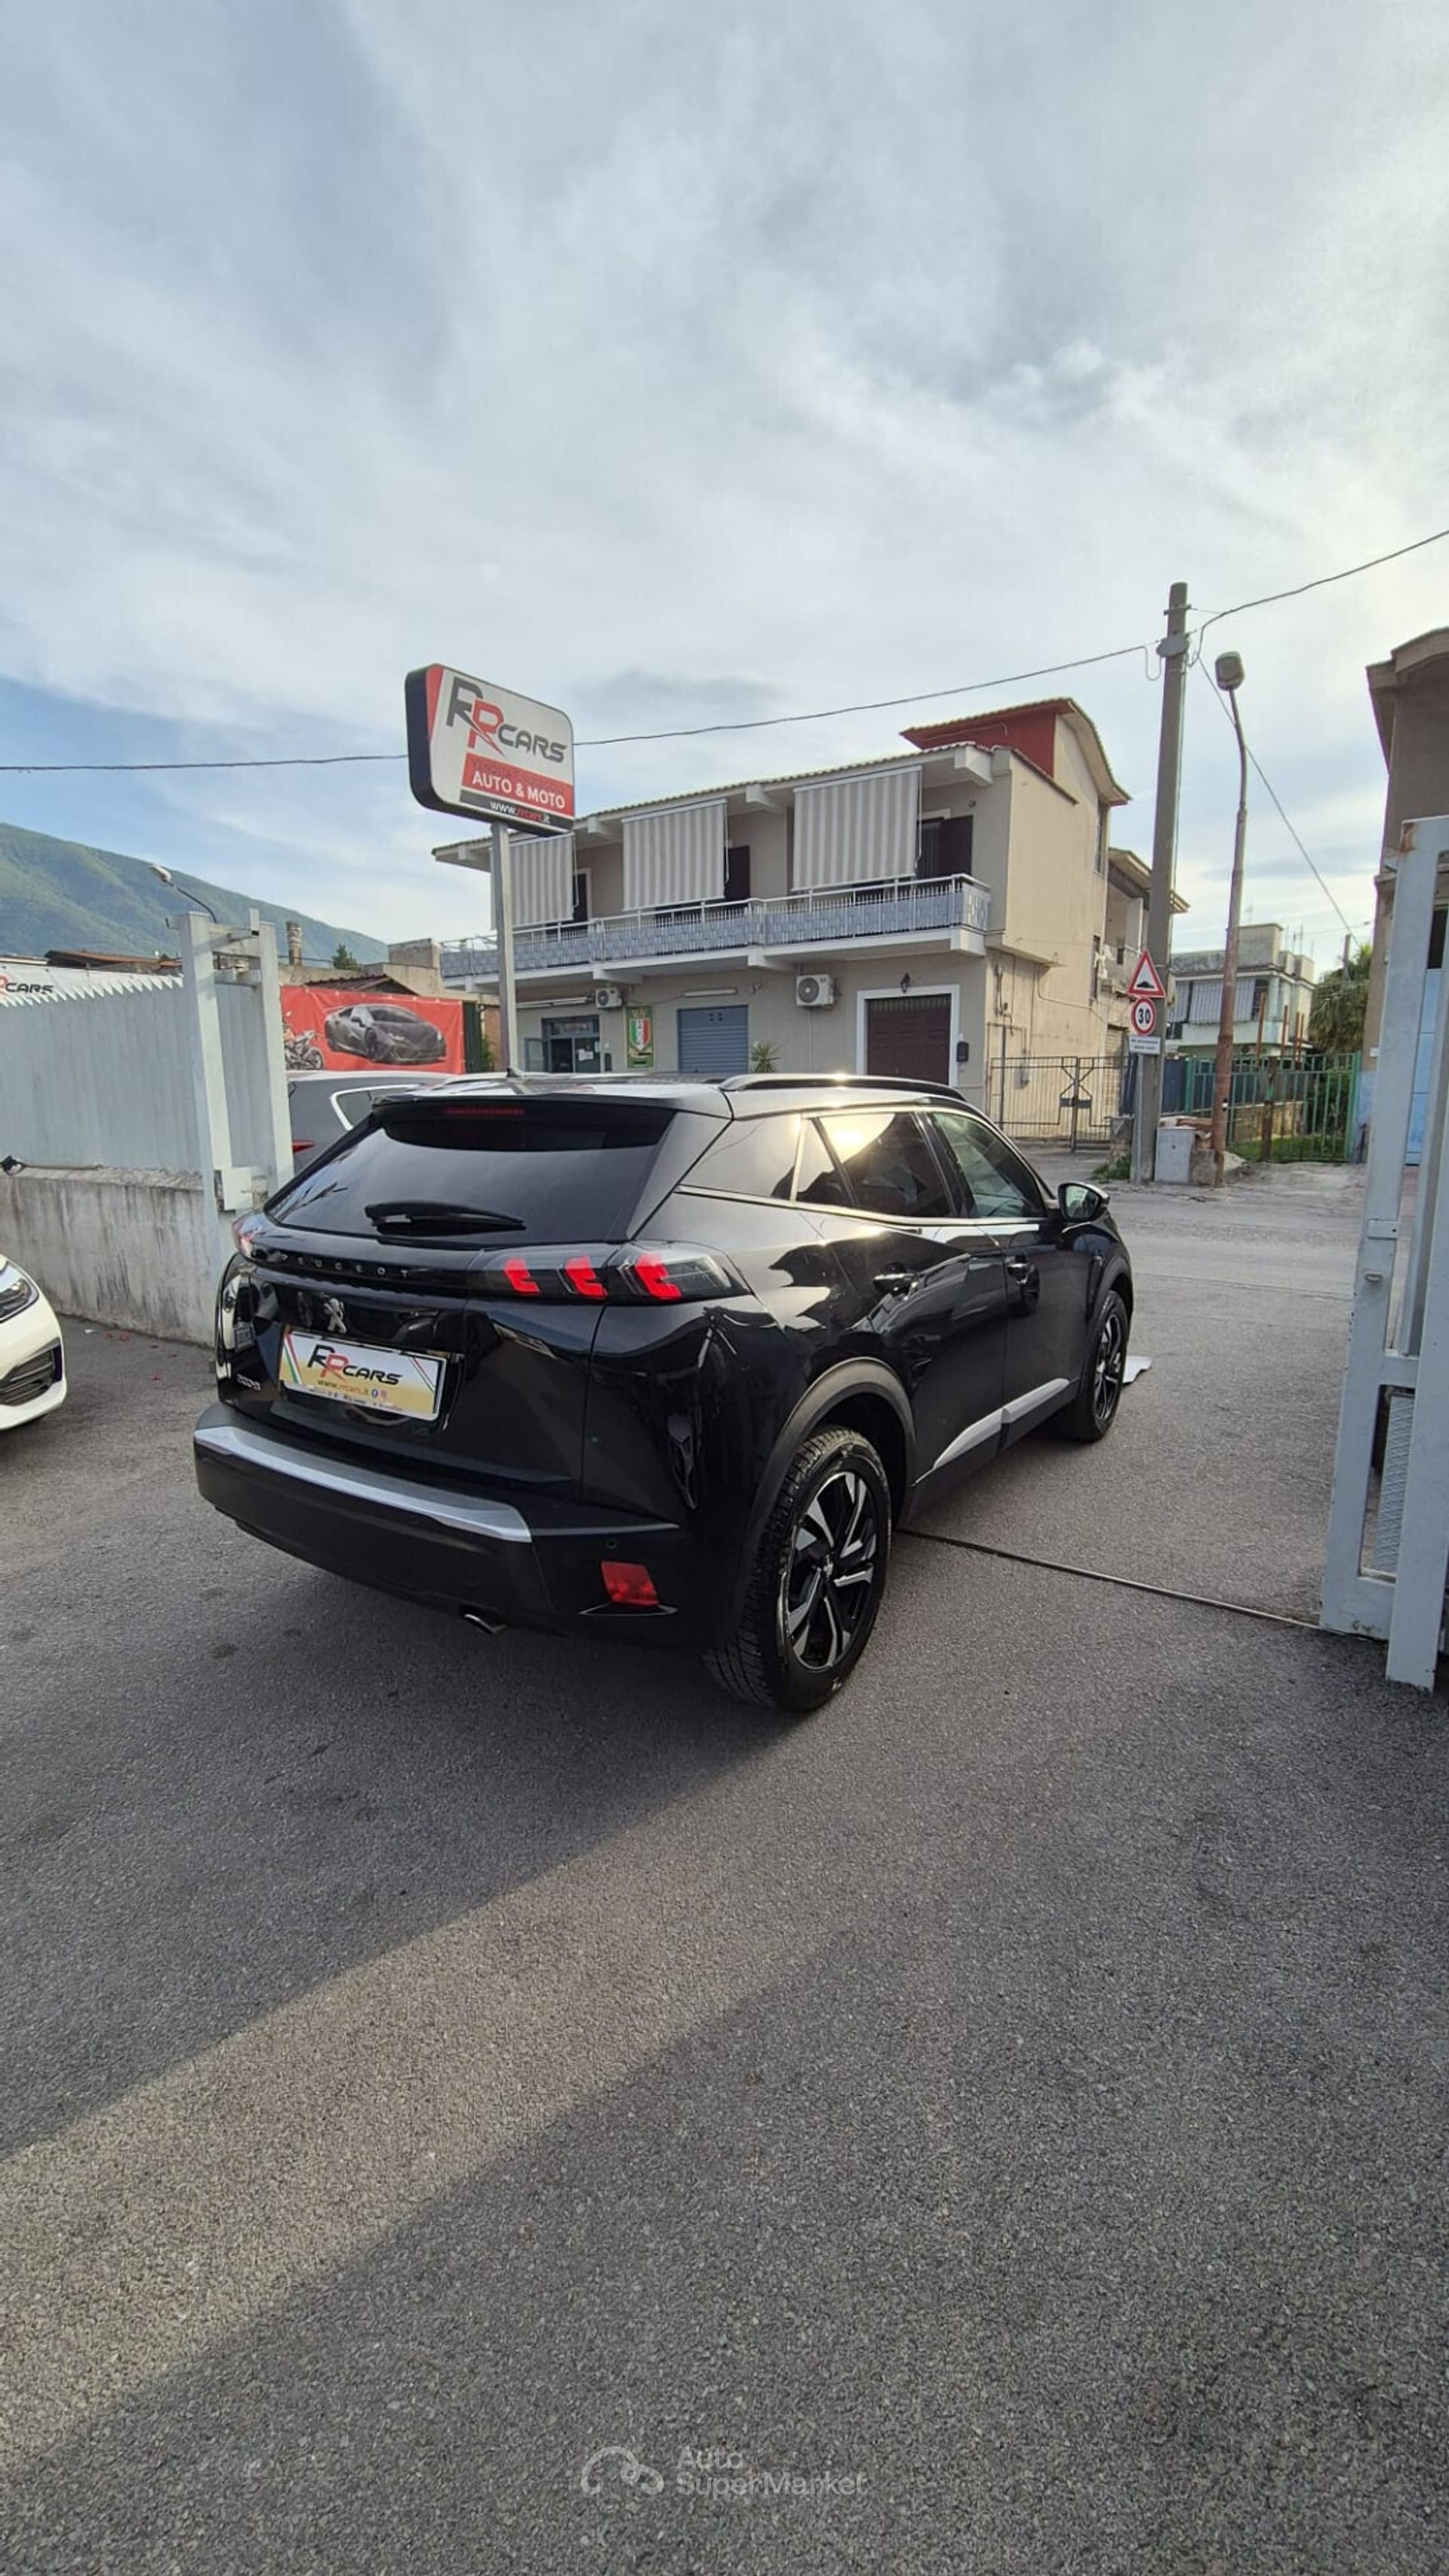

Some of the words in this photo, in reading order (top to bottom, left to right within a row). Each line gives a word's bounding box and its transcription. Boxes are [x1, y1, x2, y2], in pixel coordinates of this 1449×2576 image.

[472, 771, 512, 793] AUTO
[515, 783, 525, 798] &
[528, 786, 565, 809] MOTO
[1138, 1008, 1151, 1024] 30
